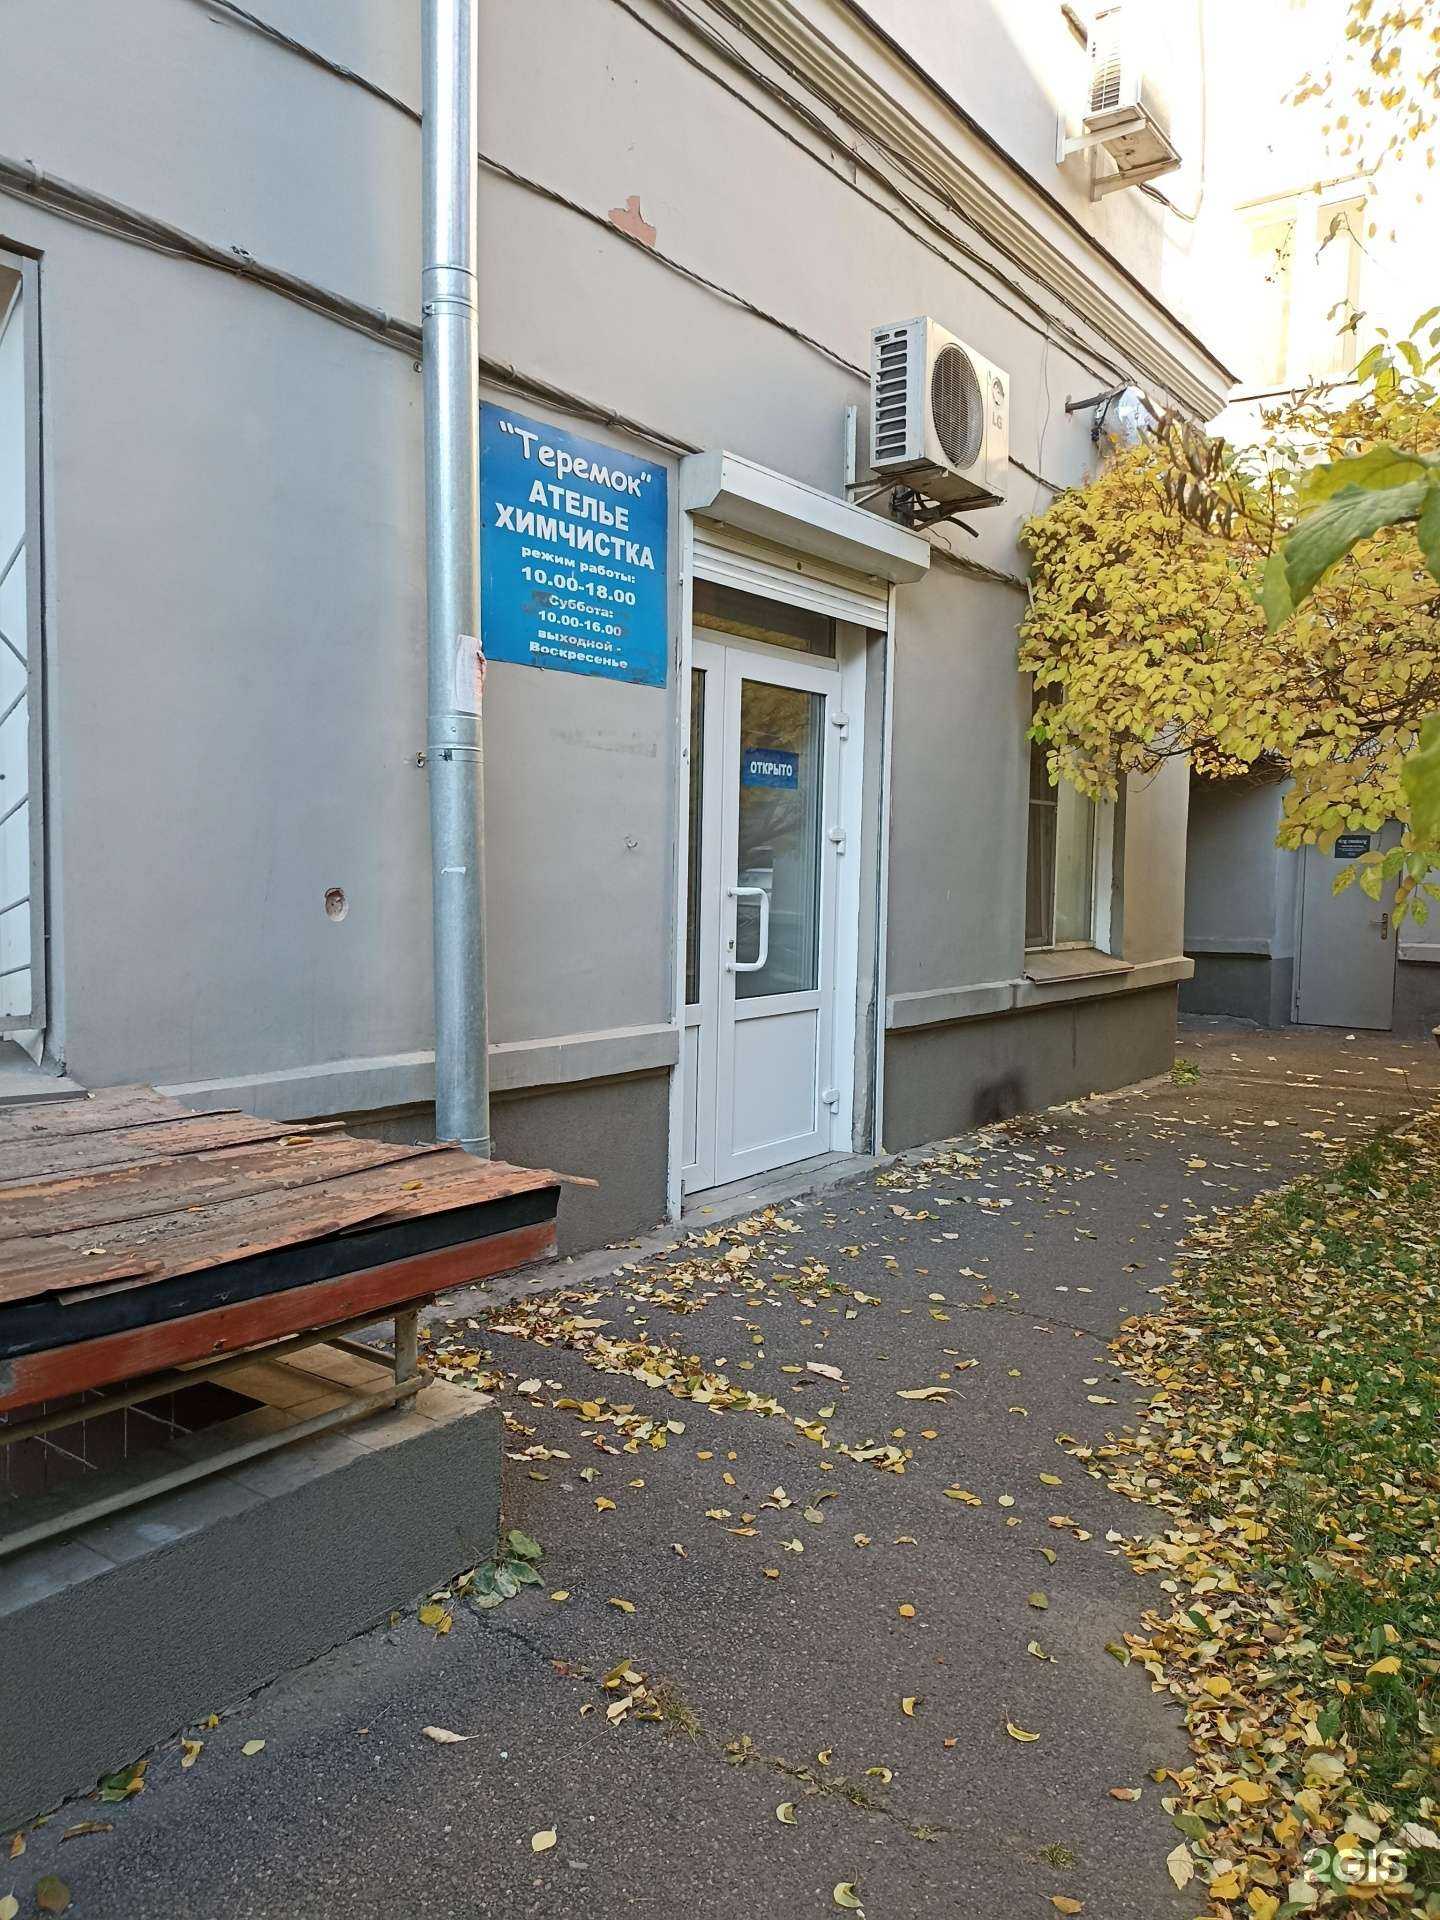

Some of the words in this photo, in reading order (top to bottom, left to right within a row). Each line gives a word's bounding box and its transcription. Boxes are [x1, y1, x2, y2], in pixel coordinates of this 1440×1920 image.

[499, 420, 652, 497] "Теремок"
[529, 479, 629, 532] АТЕЛЬЕ
[495, 502, 655, 570] ХИМЧИСТКА
[521, 546, 576, 569] режим
[580, 560, 636, 584] работы:
[521, 566, 636, 606] 10.00-18.00
[538, 610, 622, 637] 10.00-16.00
[549, 594, 614, 619] Суббота:
[529, 640, 628, 670] Воскресенье
[537, 628, 613, 652] выходной
[750, 761, 793, 777] ОТКРЫТО
